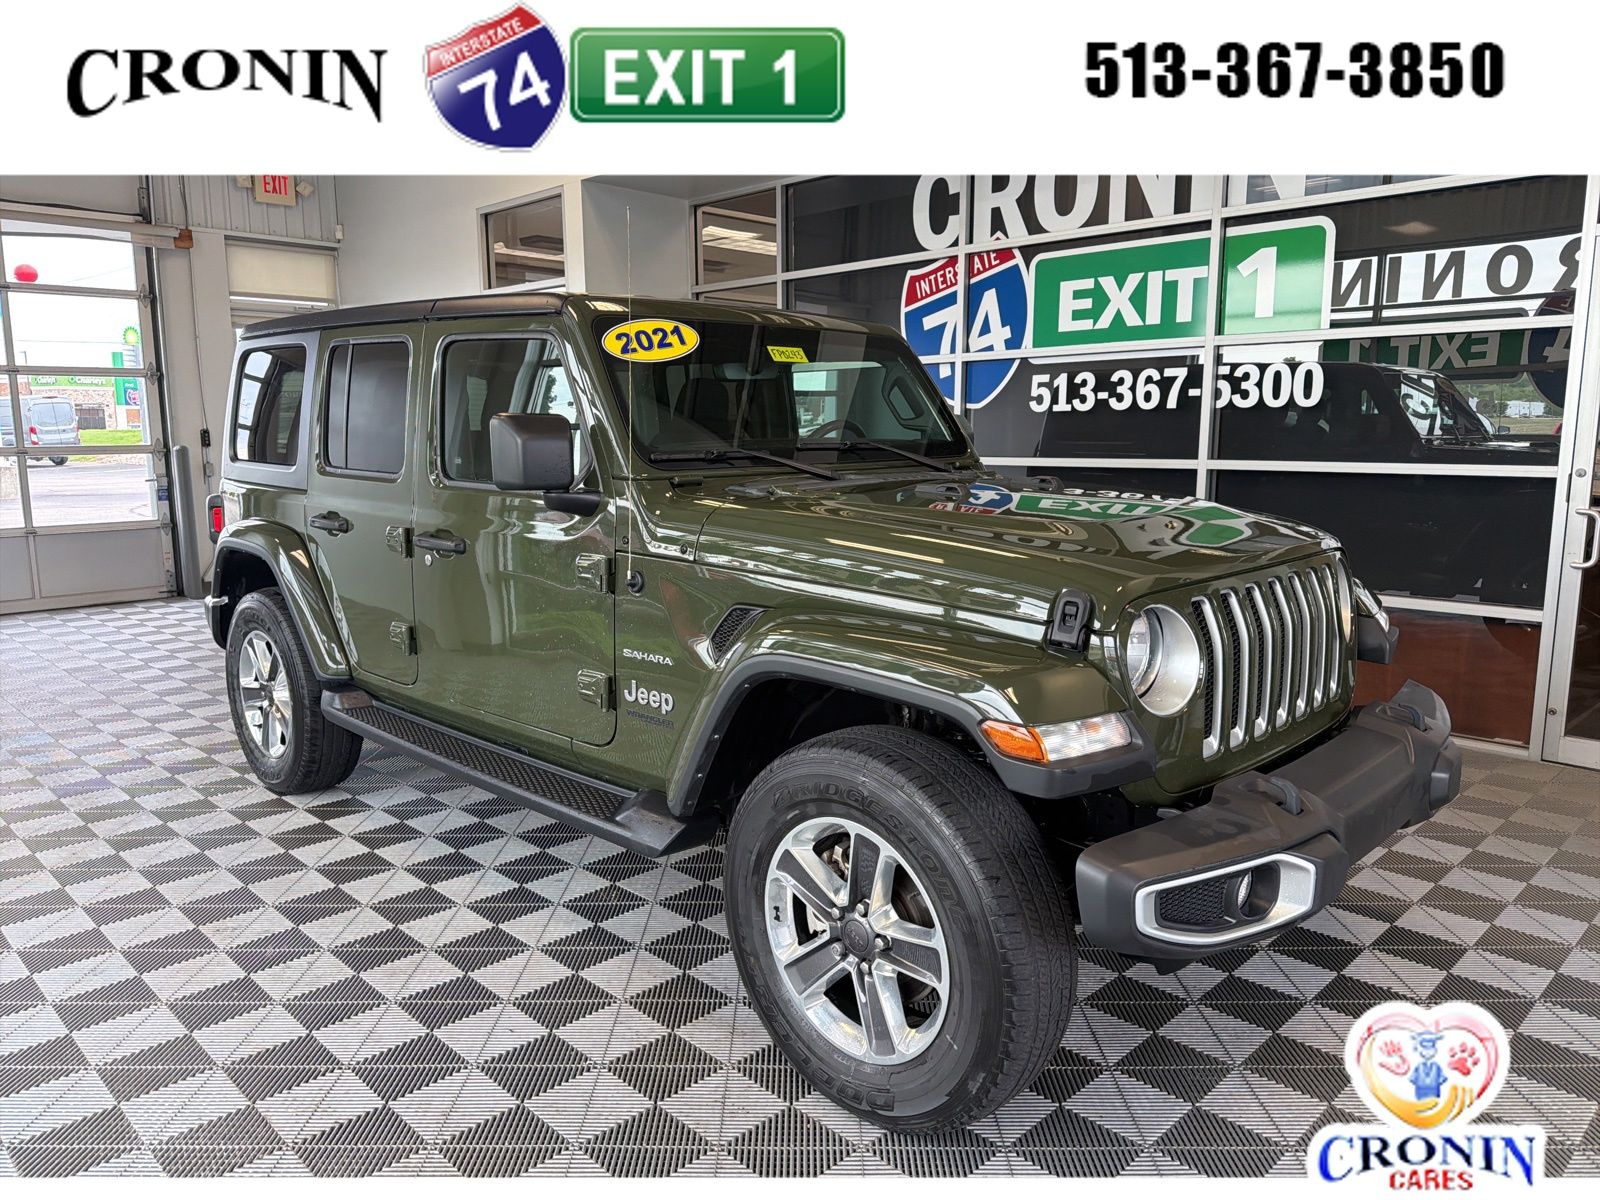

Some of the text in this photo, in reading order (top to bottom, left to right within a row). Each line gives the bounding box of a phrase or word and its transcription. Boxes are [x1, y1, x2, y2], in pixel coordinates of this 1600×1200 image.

[263, 175, 289, 196] EXIT
[915, 251, 1000, 299] INTERATE
[1058, 246, 1278, 333] EXIT 1
[615, 325, 687, 355] 2021
[922, 288, 1012, 379] 74
[1028, 362, 1325, 412] 513-367-5300
[623, 648, 674, 666] SAHARA
[624, 680, 673, 715] Jeep
